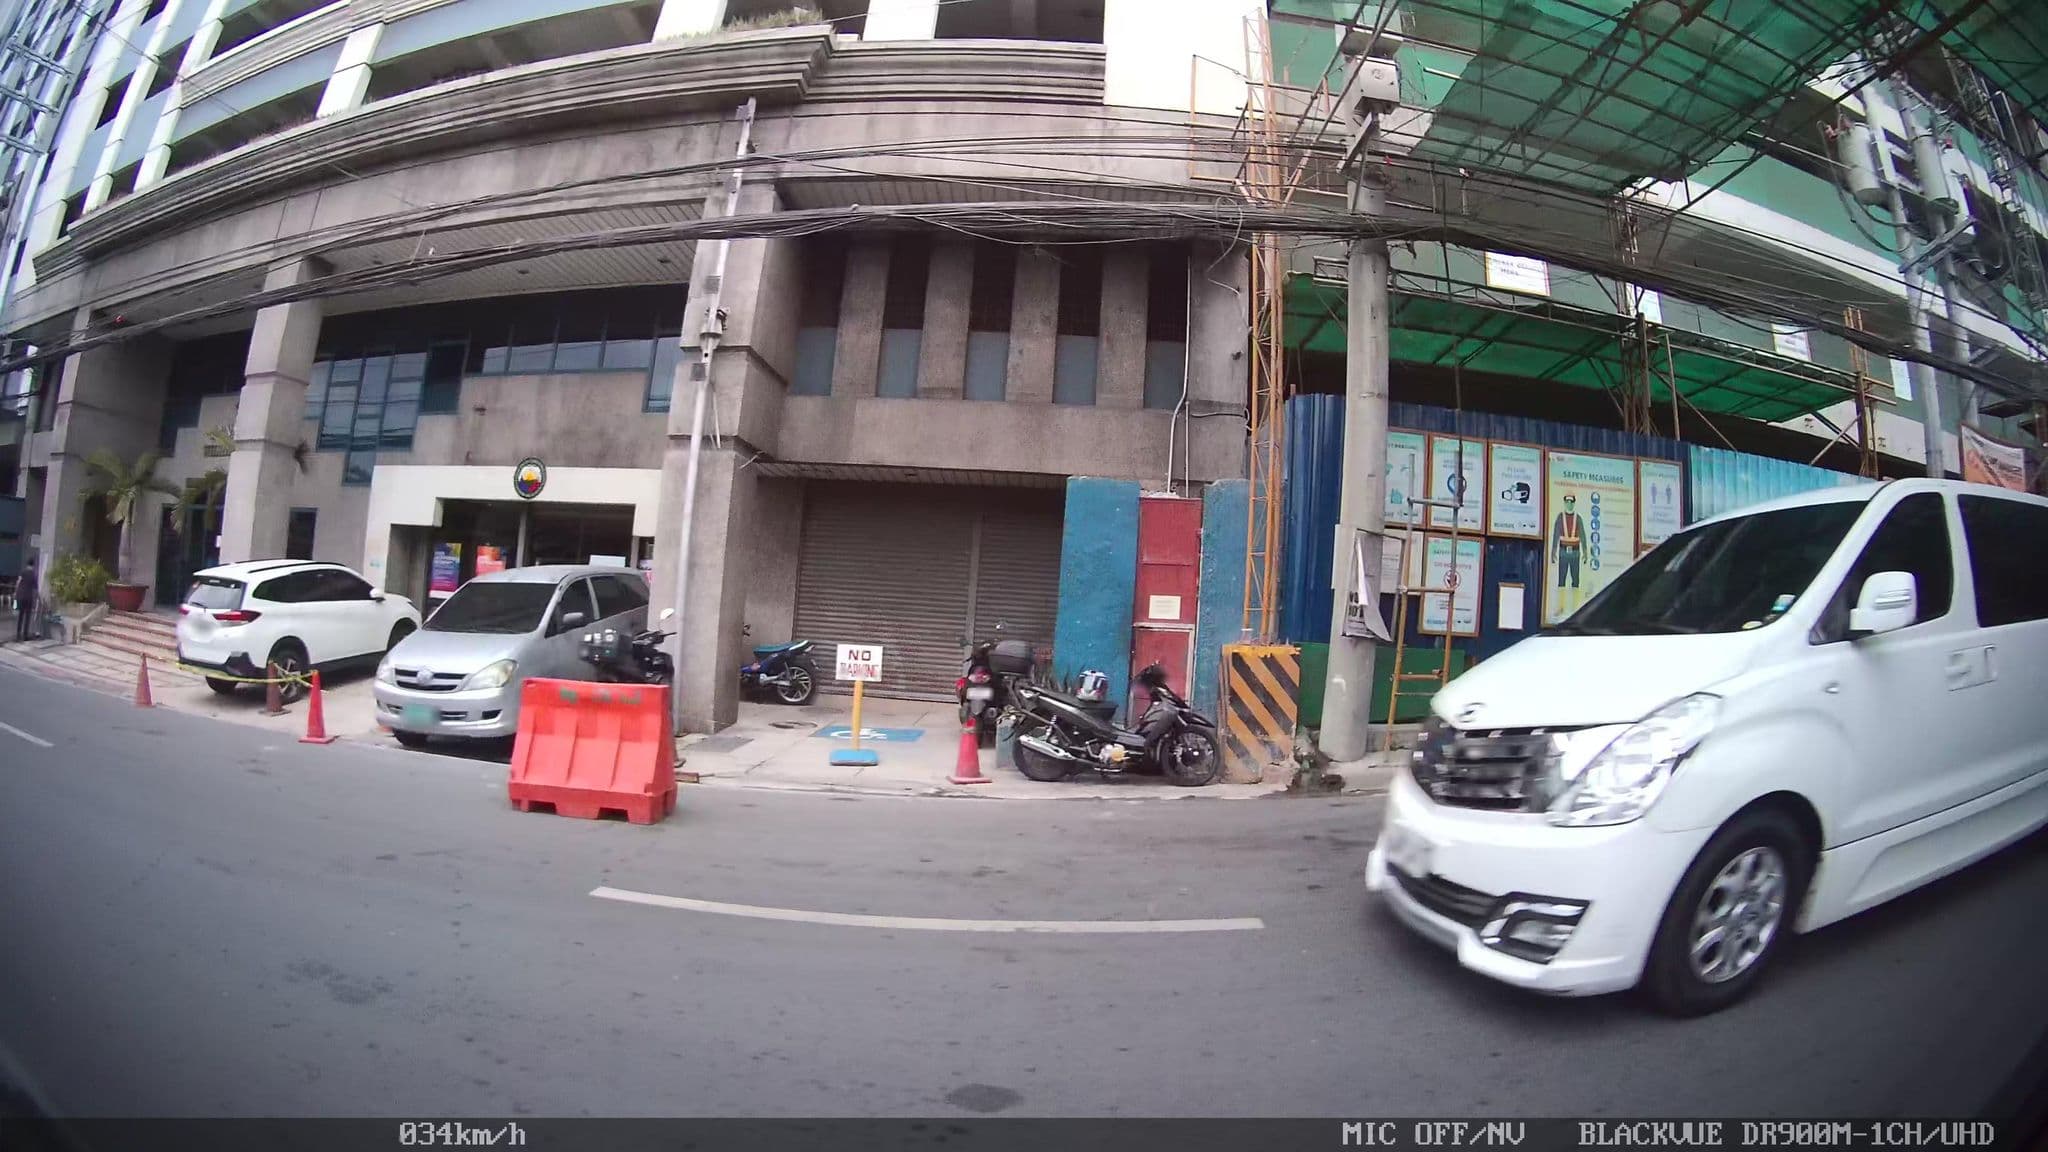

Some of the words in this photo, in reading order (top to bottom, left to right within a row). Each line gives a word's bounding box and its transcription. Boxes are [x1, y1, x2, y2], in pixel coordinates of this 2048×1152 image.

[1562, 470, 1588, 481] SAFETY
[1588, 473, 1624, 484] MEASURES
[848, 649, 872, 662] NO
